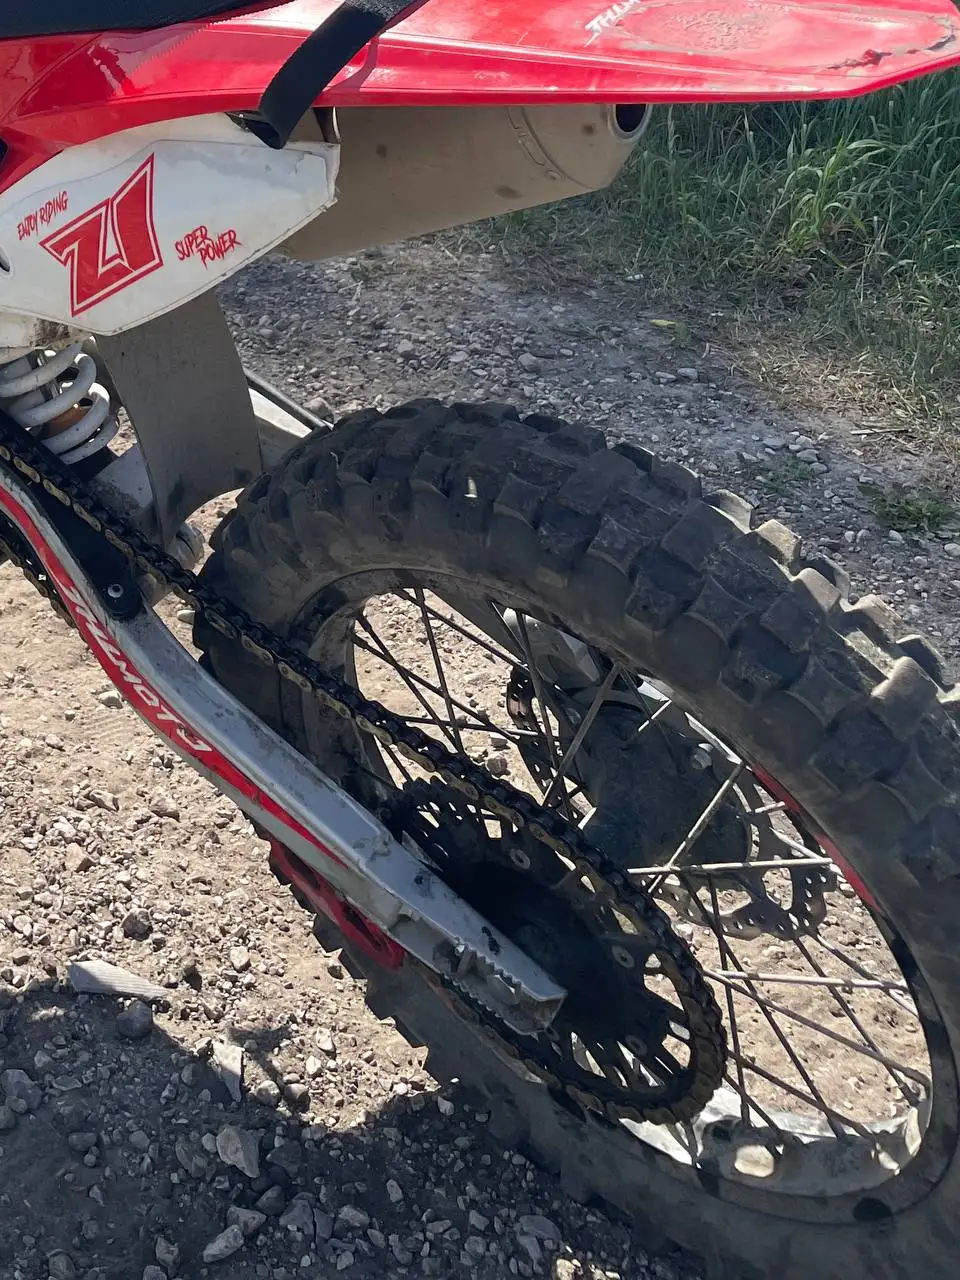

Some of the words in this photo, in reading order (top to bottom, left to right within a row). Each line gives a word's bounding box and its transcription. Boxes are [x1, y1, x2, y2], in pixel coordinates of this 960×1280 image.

[17, 210, 38, 240] ENJOY
[39, 190, 68, 226] RIDING
[175, 225, 212, 260] SUPER
[197, 229, 245, 271] POWER
